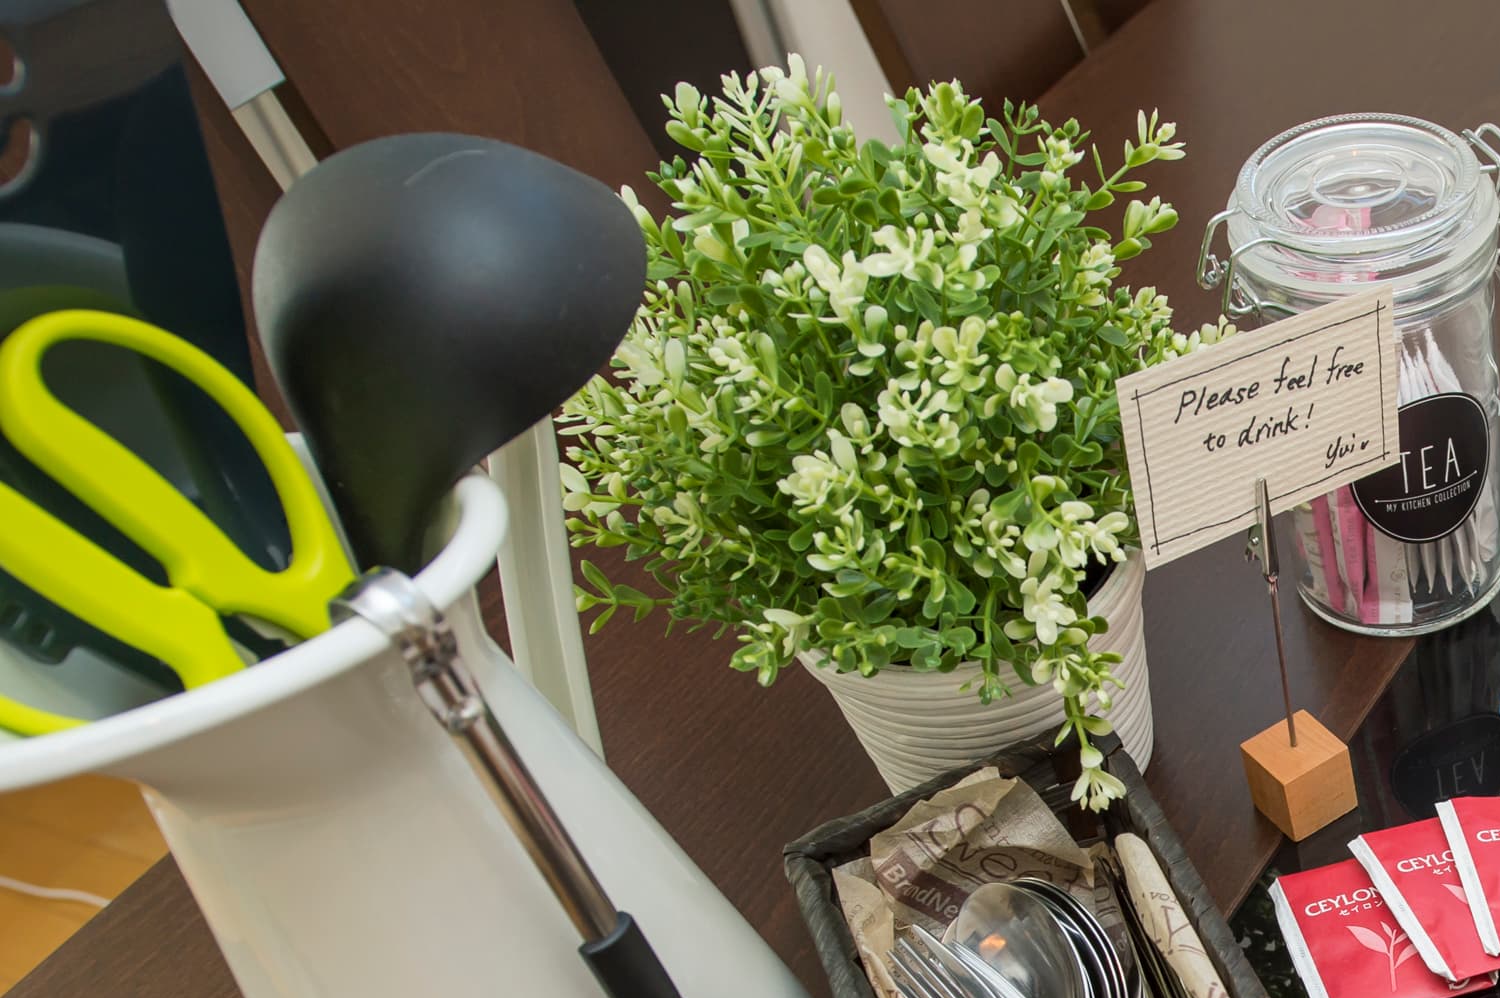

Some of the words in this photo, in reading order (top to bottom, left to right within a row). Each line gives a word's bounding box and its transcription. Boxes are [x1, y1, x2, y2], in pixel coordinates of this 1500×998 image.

[1173, 382, 1260, 424] Please
[1273, 354, 1318, 394] feel
[1325, 346, 1365, 385] free
[1202, 432, 1227, 452] to
[1400, 437, 1461, 494] TEA
[1386, 503, 1398, 513] MY
[1401, 498, 1432, 512] KITCHEN
[1434, 479, 1471, 504] COLLECTION
[1396, 850, 1455, 873] CEYLO
